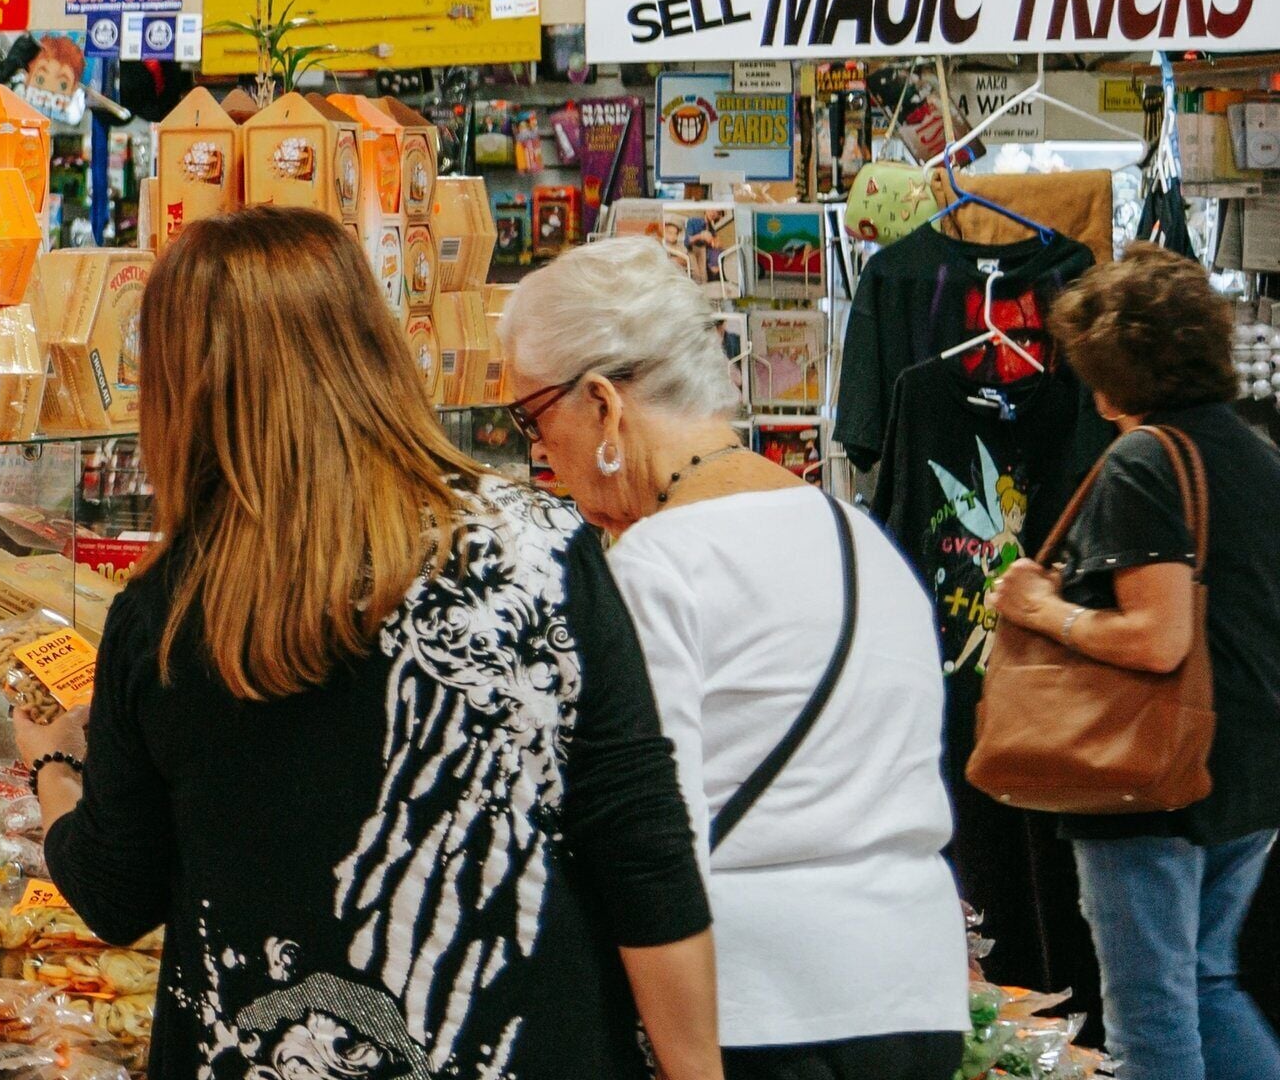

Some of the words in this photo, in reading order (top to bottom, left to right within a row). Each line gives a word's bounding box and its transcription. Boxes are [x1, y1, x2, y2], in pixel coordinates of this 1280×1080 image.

[716, 95, 786, 112] GREETING
[718, 115, 788, 145] CARDS
[90, 349, 113, 410] CHOCOLATE
[25, 634, 73, 660] FLORIDA
[36, 643, 76, 668] SNACK
[56, 673, 85, 691] Sesame
